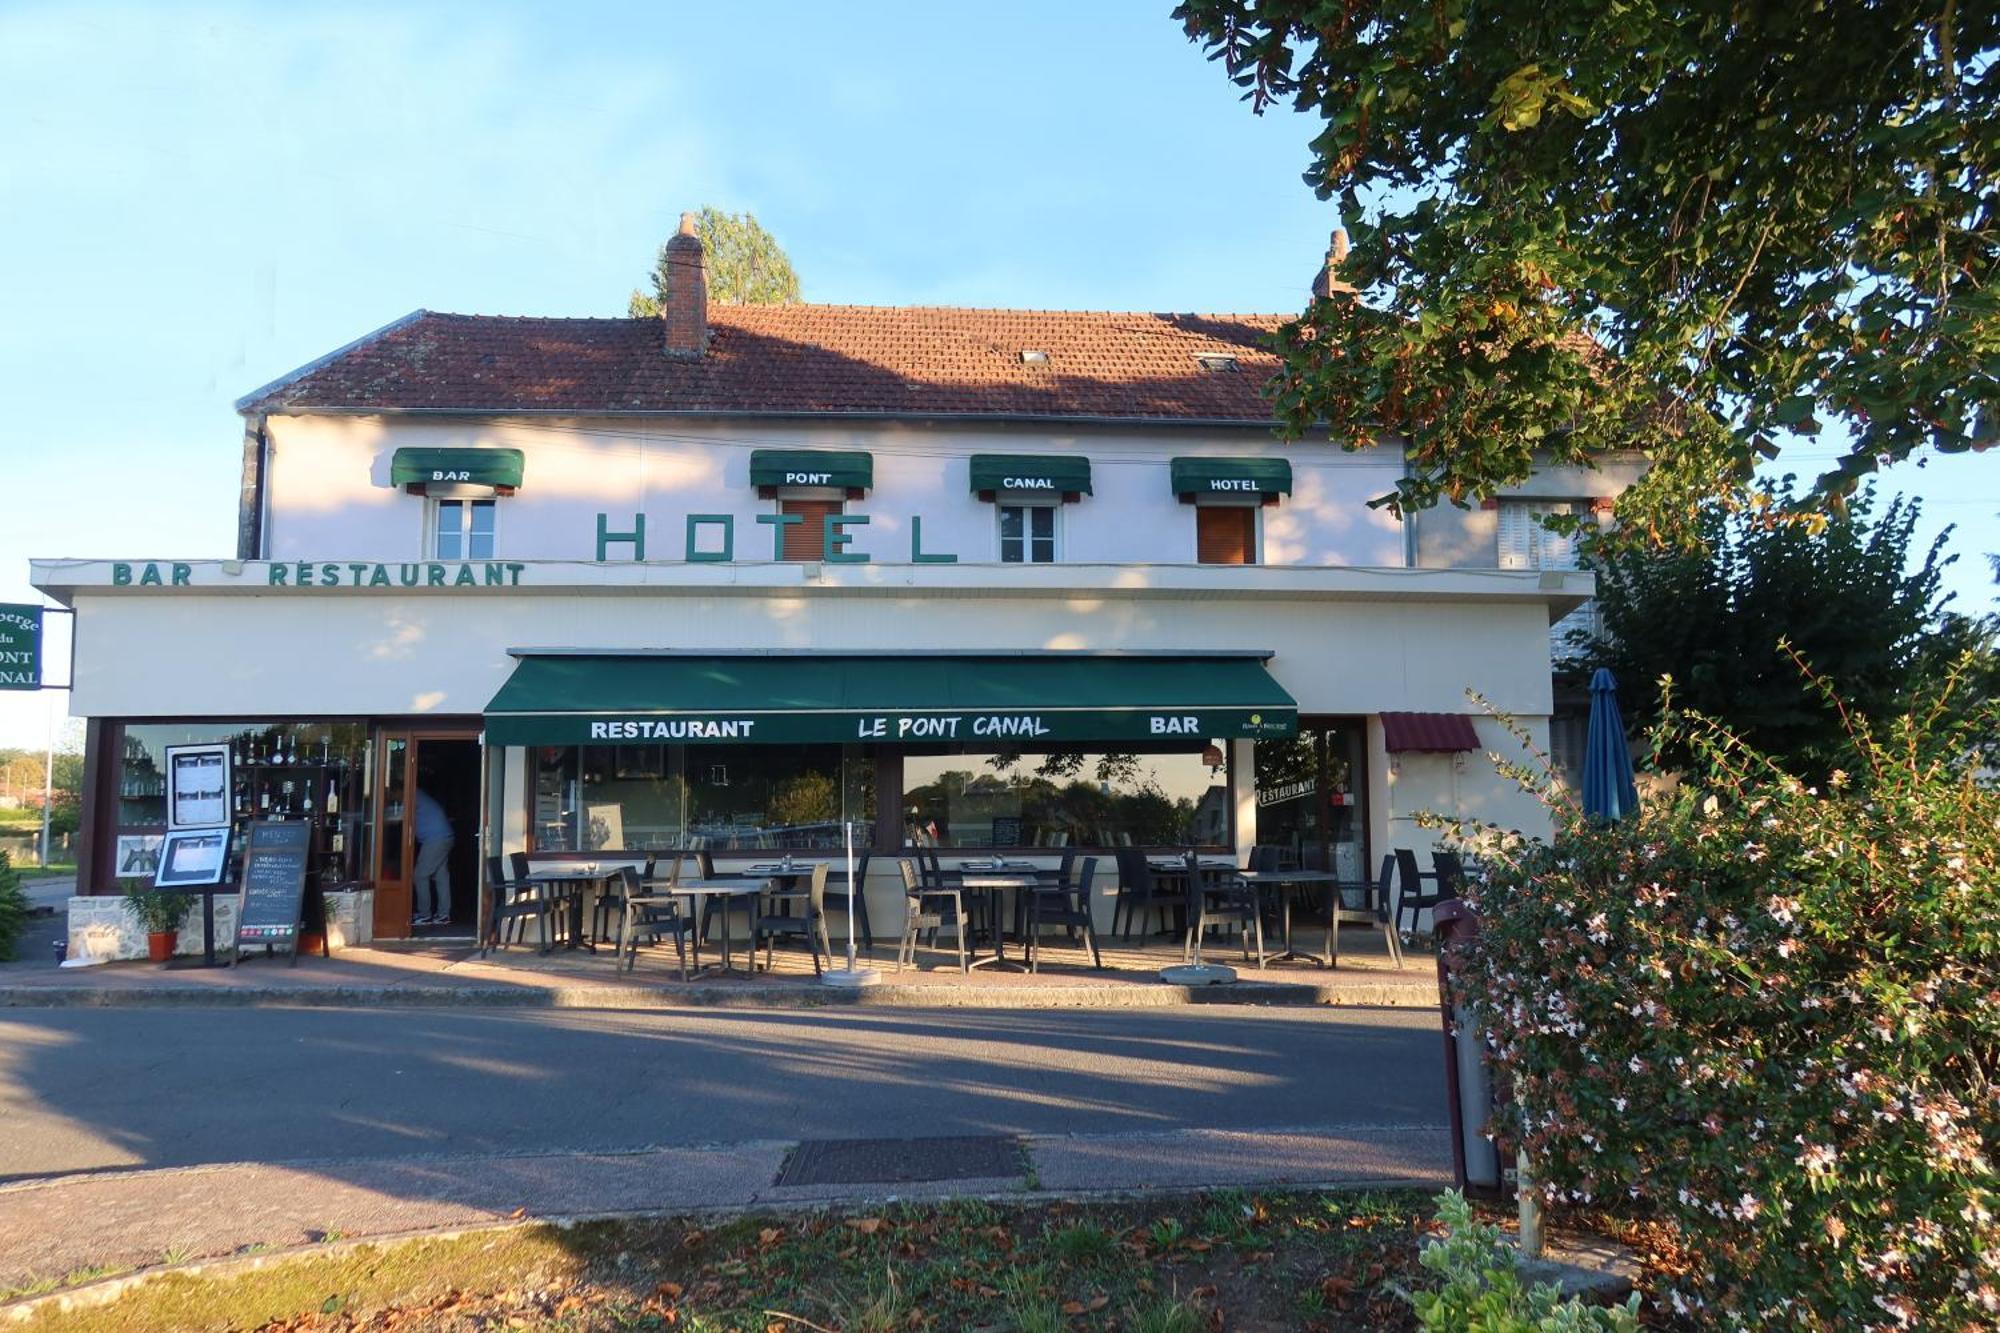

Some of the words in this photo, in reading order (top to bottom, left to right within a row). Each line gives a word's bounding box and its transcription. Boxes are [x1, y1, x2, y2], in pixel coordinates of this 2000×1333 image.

[432, 471, 470, 481] BAR
[786, 472, 832, 484] PONT
[1003, 477, 1055, 489] CANAL
[1210, 479, 1260, 490] HOTEL
[597, 513, 958, 563] HOTEL
[112, 563, 193, 586] BAR
[591, 720, 755, 739] RESTAURANT
[858, 718, 887, 738] LE
[898, 717, 962, 738] PONT
[973, 716, 1050, 738] CANAL
[1150, 716, 1200, 734] BAR
